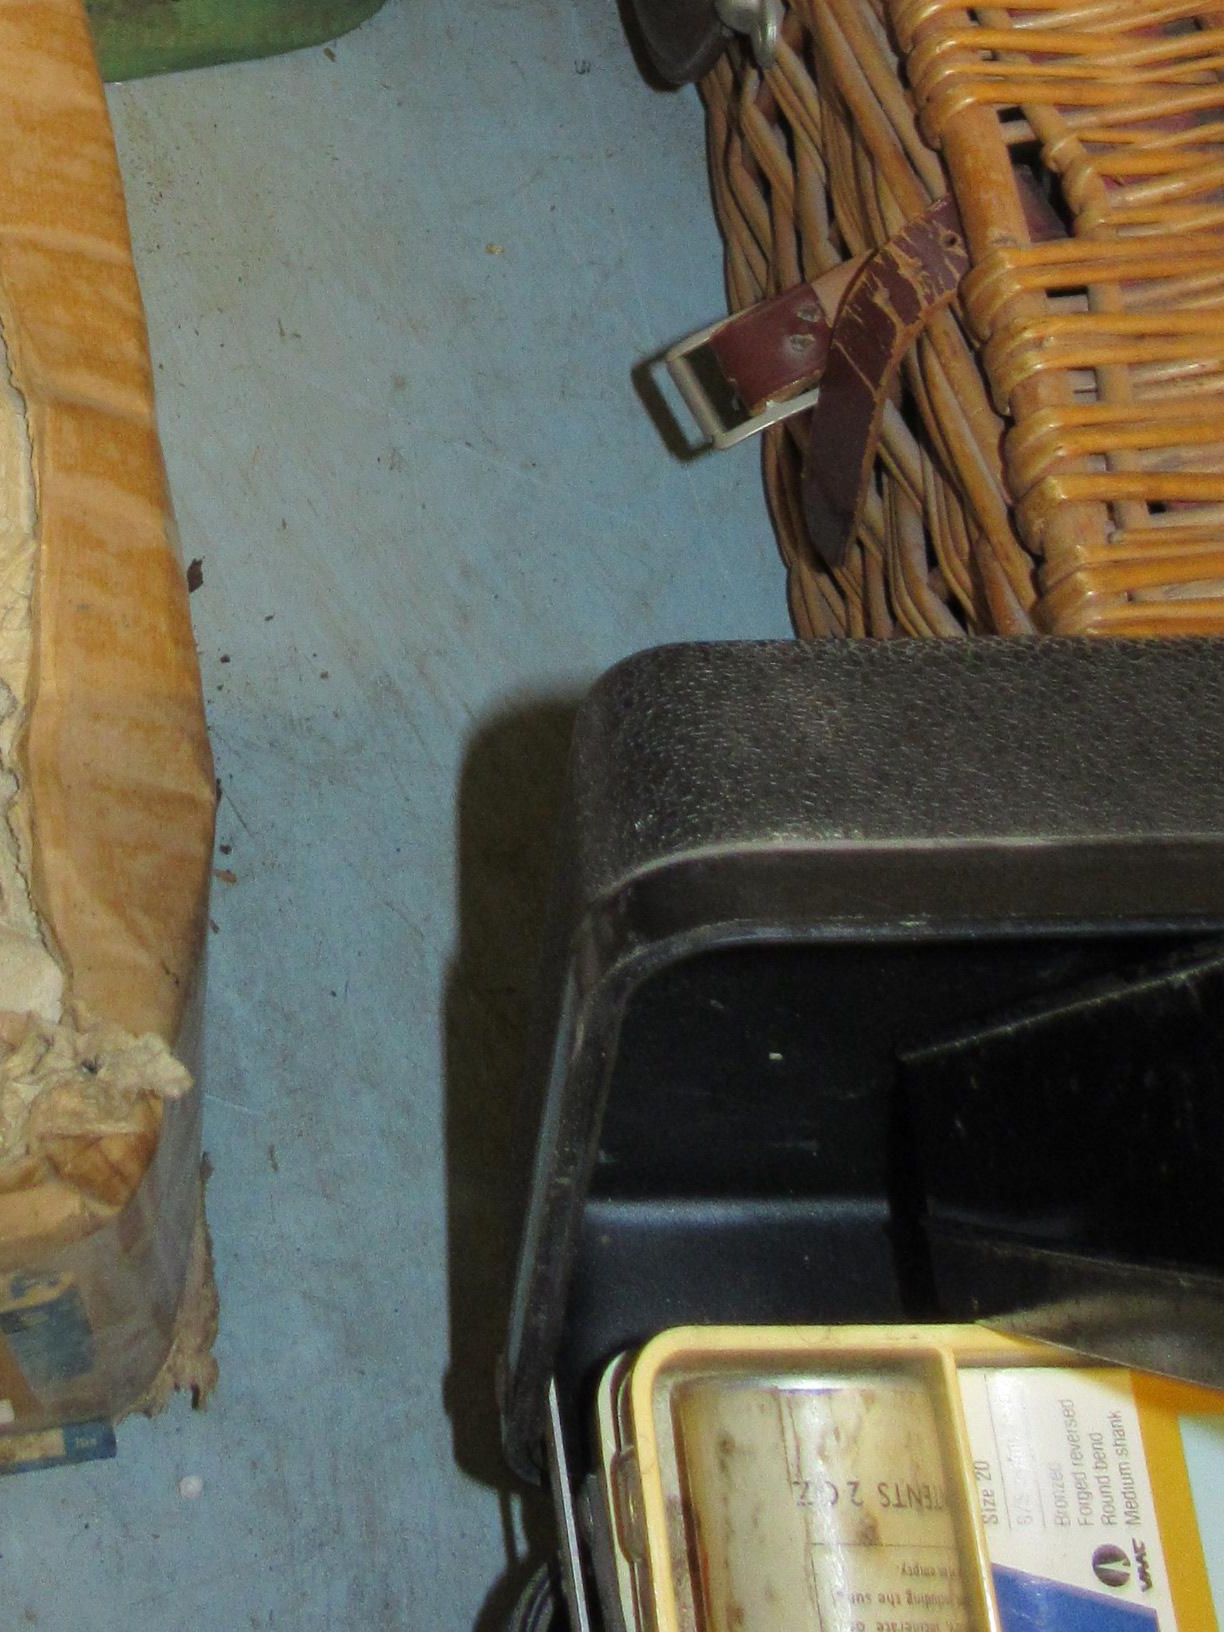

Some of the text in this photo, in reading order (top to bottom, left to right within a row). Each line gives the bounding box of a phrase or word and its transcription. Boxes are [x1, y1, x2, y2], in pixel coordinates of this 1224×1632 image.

[973, 1459, 999, 1525] Size 20
[1057, 1398, 1095, 1526] Forged reversed
[1088, 1431, 1118, 1526] Round bend
[1107, 1409, 1142, 1526] Medium shank
